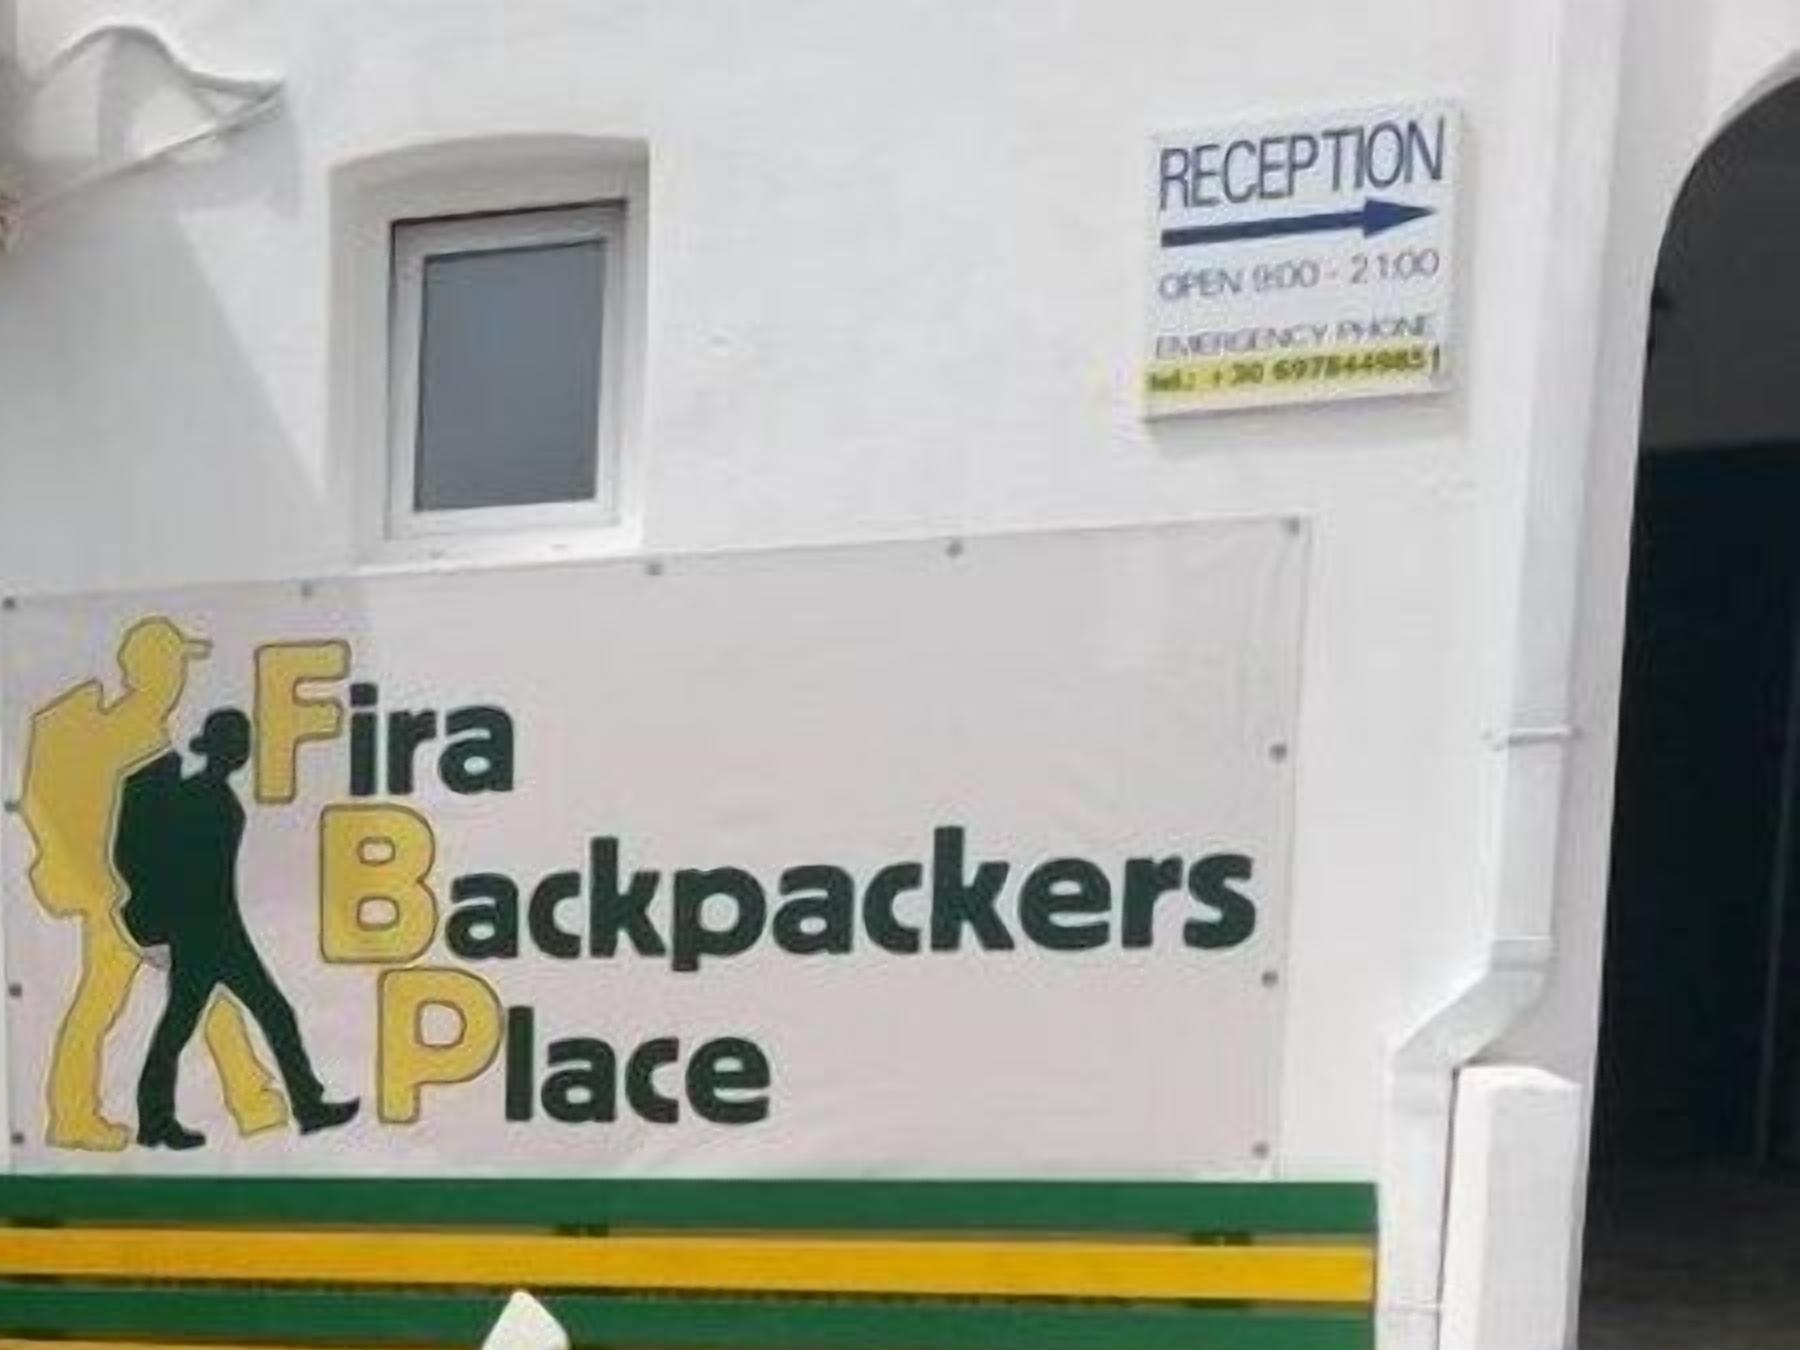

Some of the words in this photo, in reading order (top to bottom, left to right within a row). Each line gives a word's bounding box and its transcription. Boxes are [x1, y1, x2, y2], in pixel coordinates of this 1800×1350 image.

[1159, 116, 1446, 212] RECEPTION
[1155, 322, 1330, 361] EMERGENCY
[1158, 266, 1243, 301] OPEN
[1253, 259, 1320, 292] 9:00
[252, 640, 516, 806] Fira
[319, 803, 1259, 972] Backpackers
[374, 968, 772, 1127] Place
